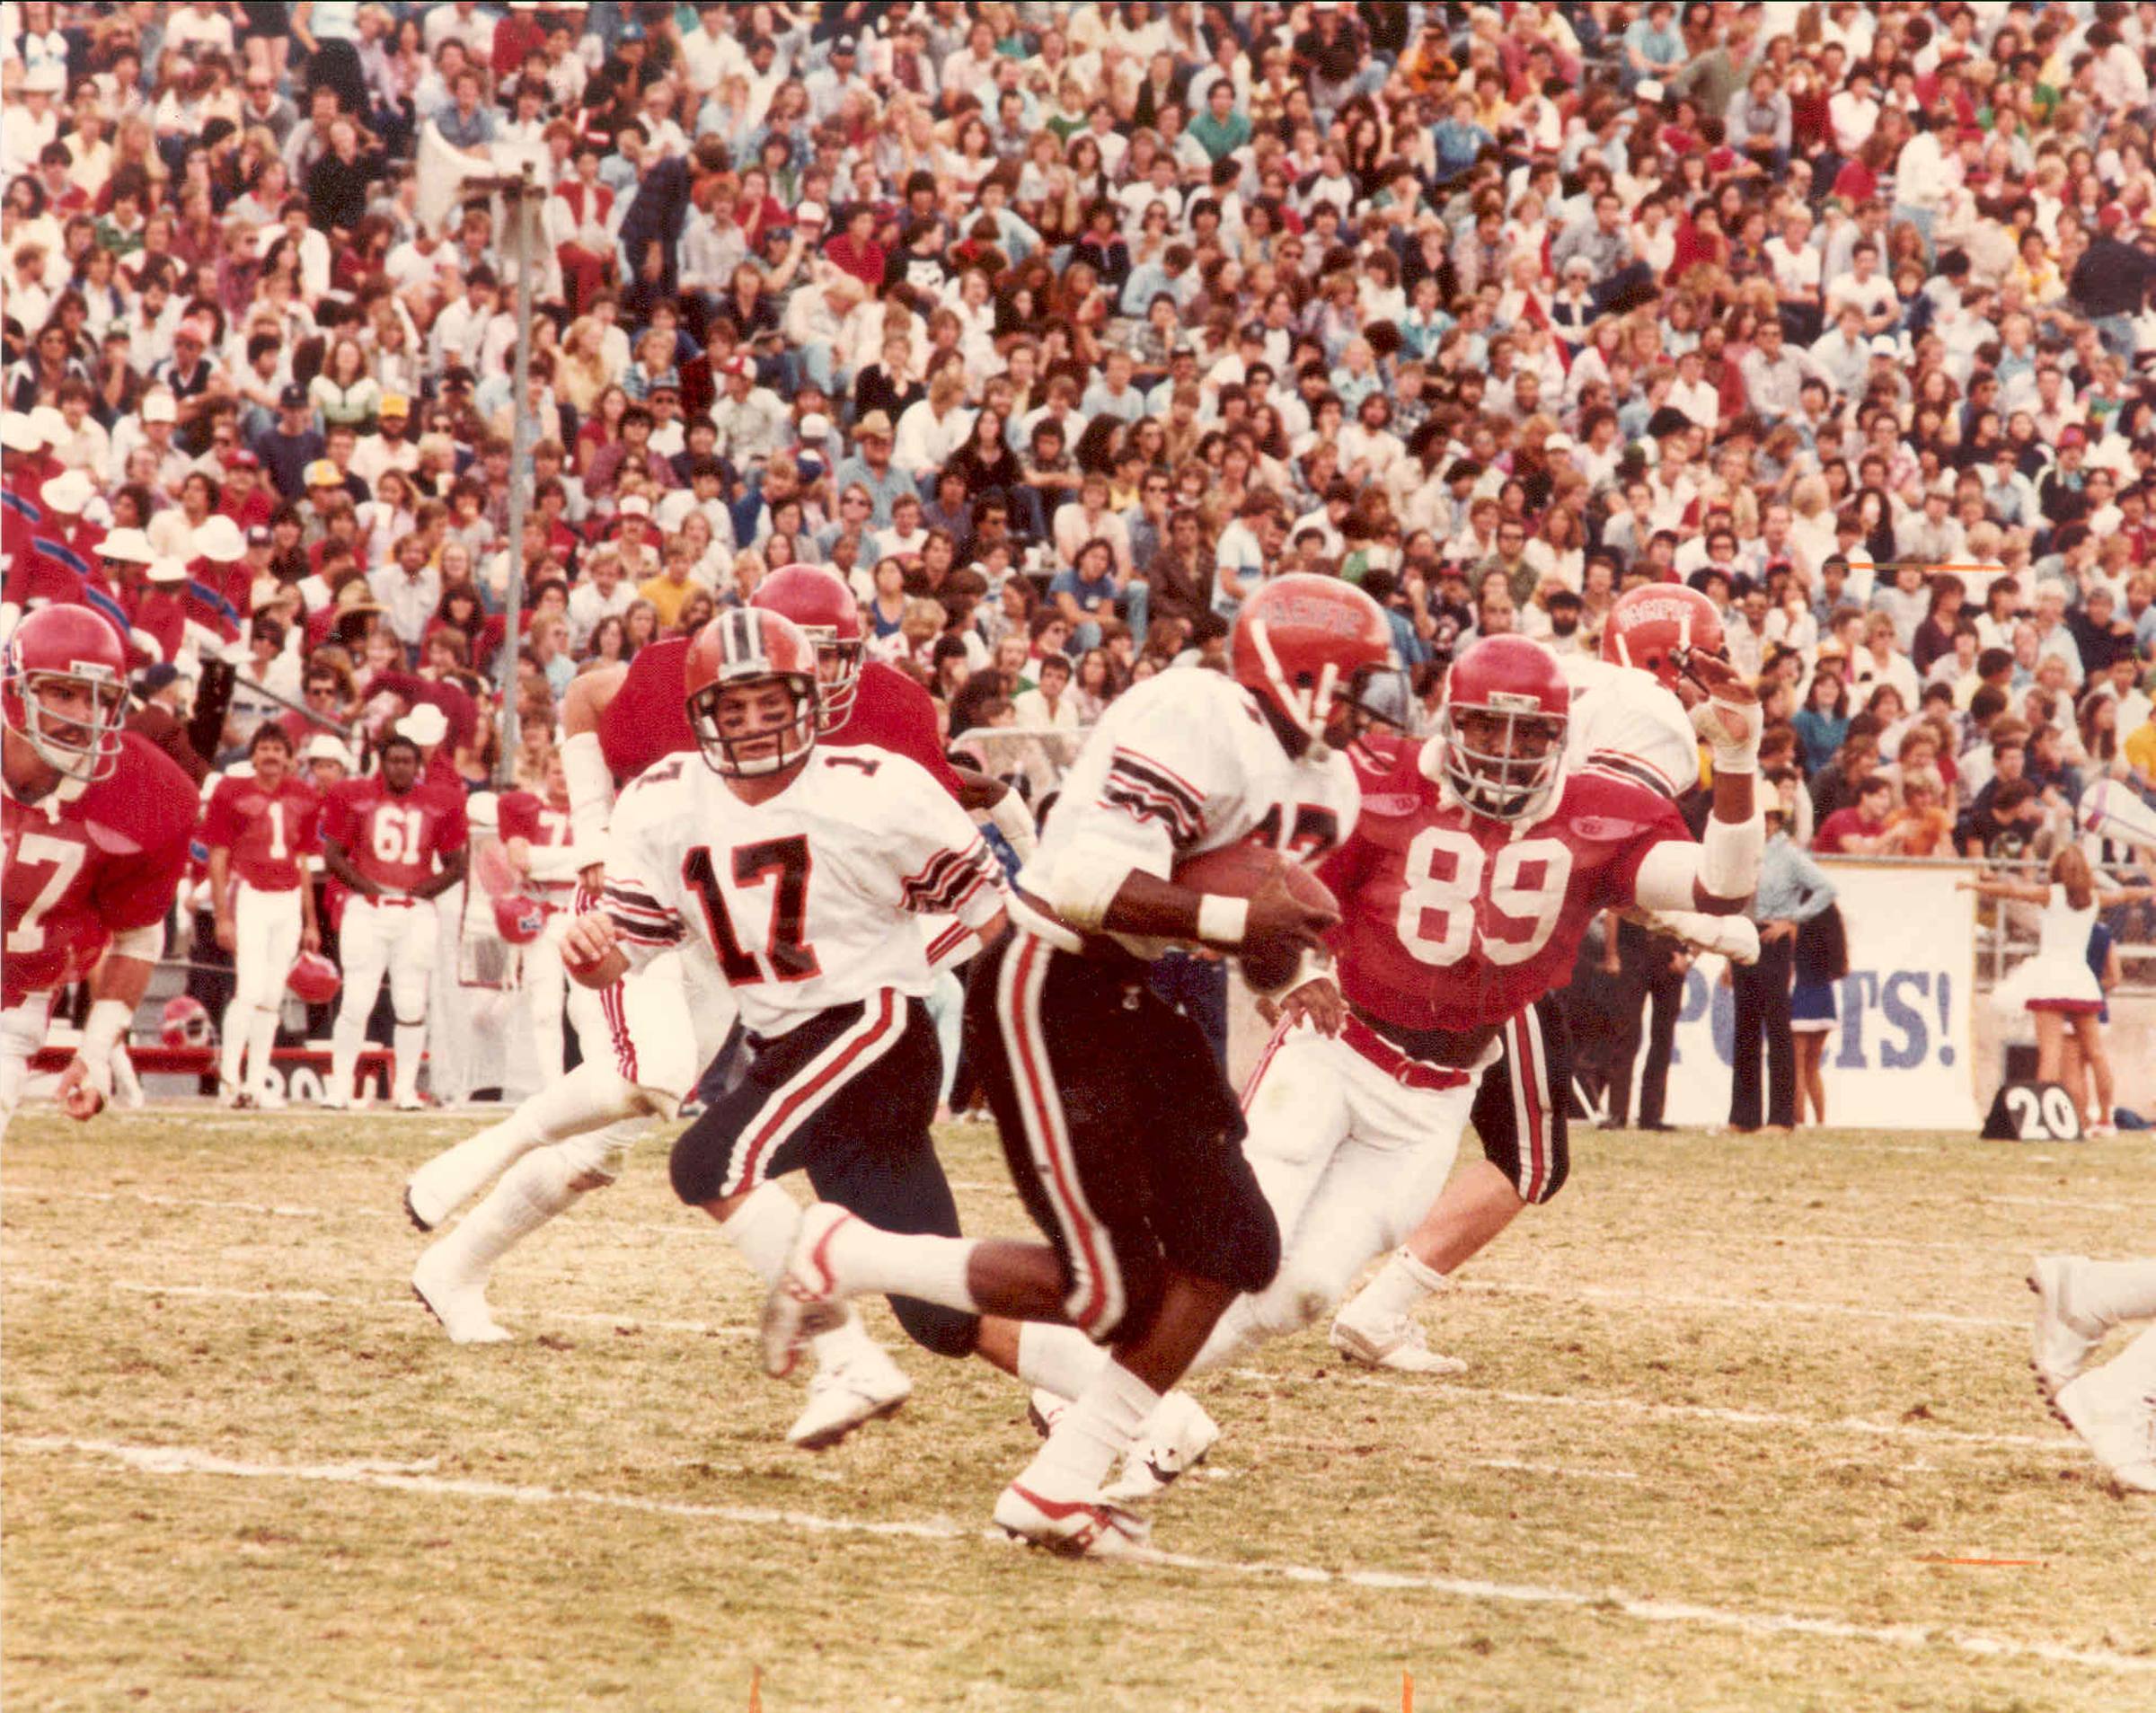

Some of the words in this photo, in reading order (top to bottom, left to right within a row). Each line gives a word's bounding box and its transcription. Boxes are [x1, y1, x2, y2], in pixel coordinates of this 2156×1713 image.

[269, 802, 287, 859] 1
[373, 806, 422, 865] 61
[2, 832, 86, 953] 7
[681, 834, 822, 986] 17
[1396, 826, 1572, 967] 89
[2006, 1087, 2080, 1140] 20
